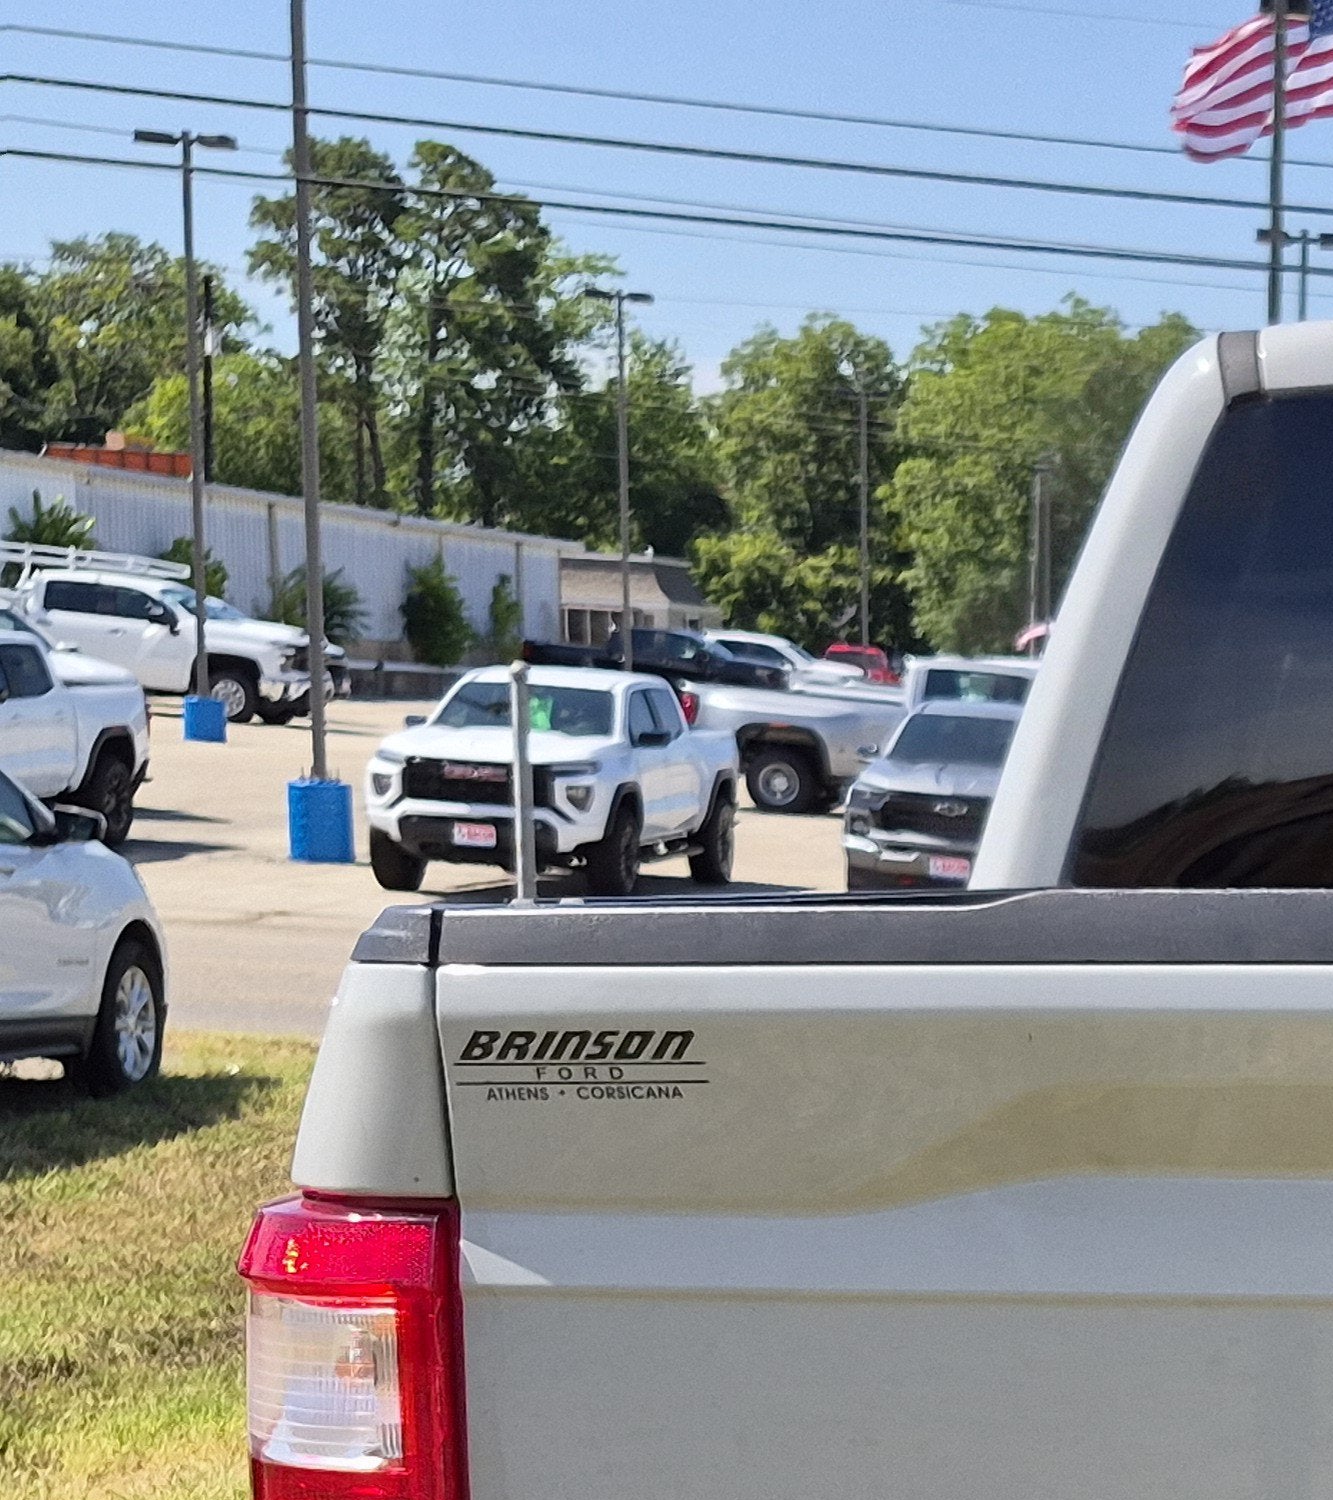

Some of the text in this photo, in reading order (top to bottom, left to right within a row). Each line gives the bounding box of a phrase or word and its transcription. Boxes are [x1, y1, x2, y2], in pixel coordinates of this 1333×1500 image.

[459, 1029, 696, 1061] BRINSON
[536, 1066, 625, 1081] FORD
[486, 1085, 684, 1101] ATHENS CORSICANA
